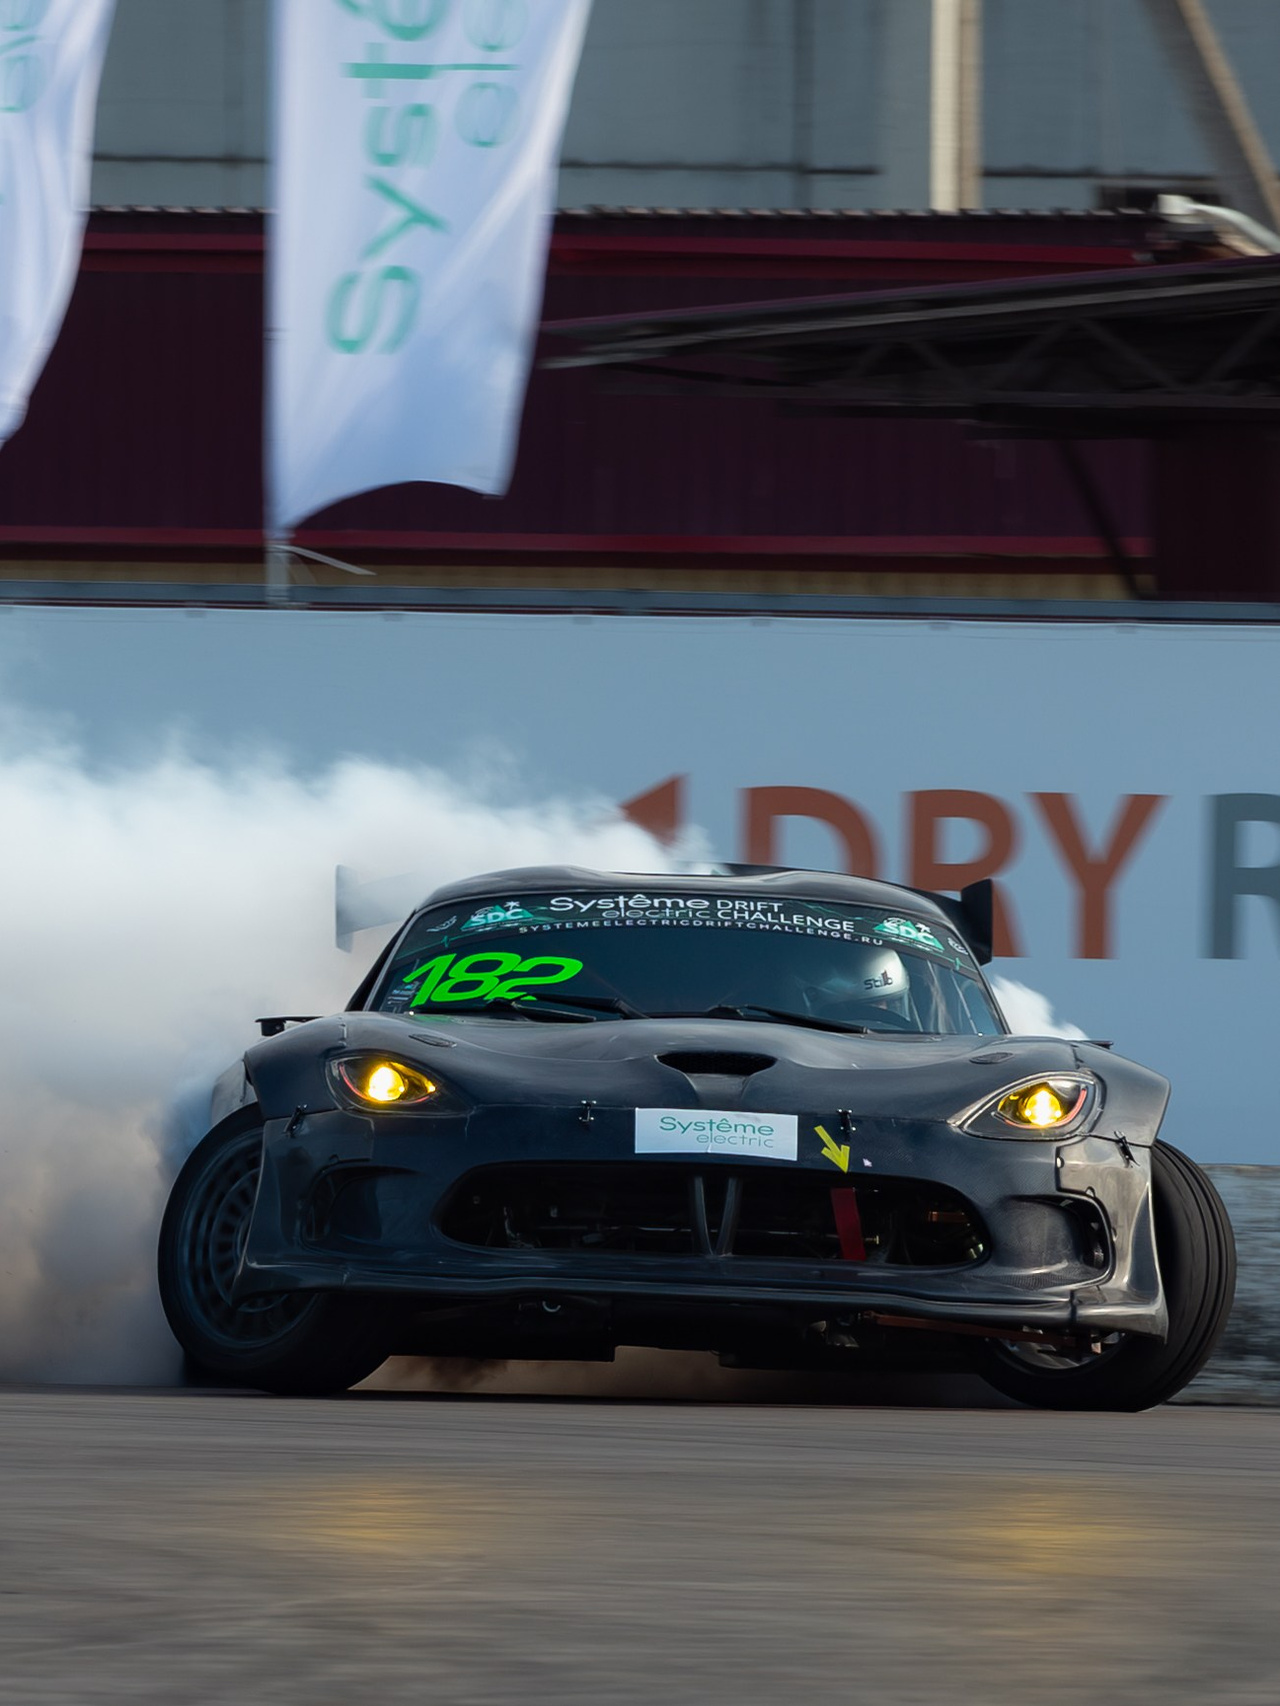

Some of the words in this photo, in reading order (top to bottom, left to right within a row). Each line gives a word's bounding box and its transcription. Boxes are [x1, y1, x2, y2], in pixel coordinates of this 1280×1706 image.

[549, 894, 710, 913] Systême
[717, 899, 784, 913] DRIFT
[470, 908, 524, 926] SDC
[602, 908, 711, 919] electric
[716, 909, 855, 933] CHALLENGE
[519, 919, 884, 946] SYSTEMEELECTRICDRIFTCHALLENGE.RU
[882, 920, 937, 947] SDC
[402, 952, 584, 1008] 182
[658, 1116, 775, 1136] Systême
[695, 1132, 775, 1149] electric
